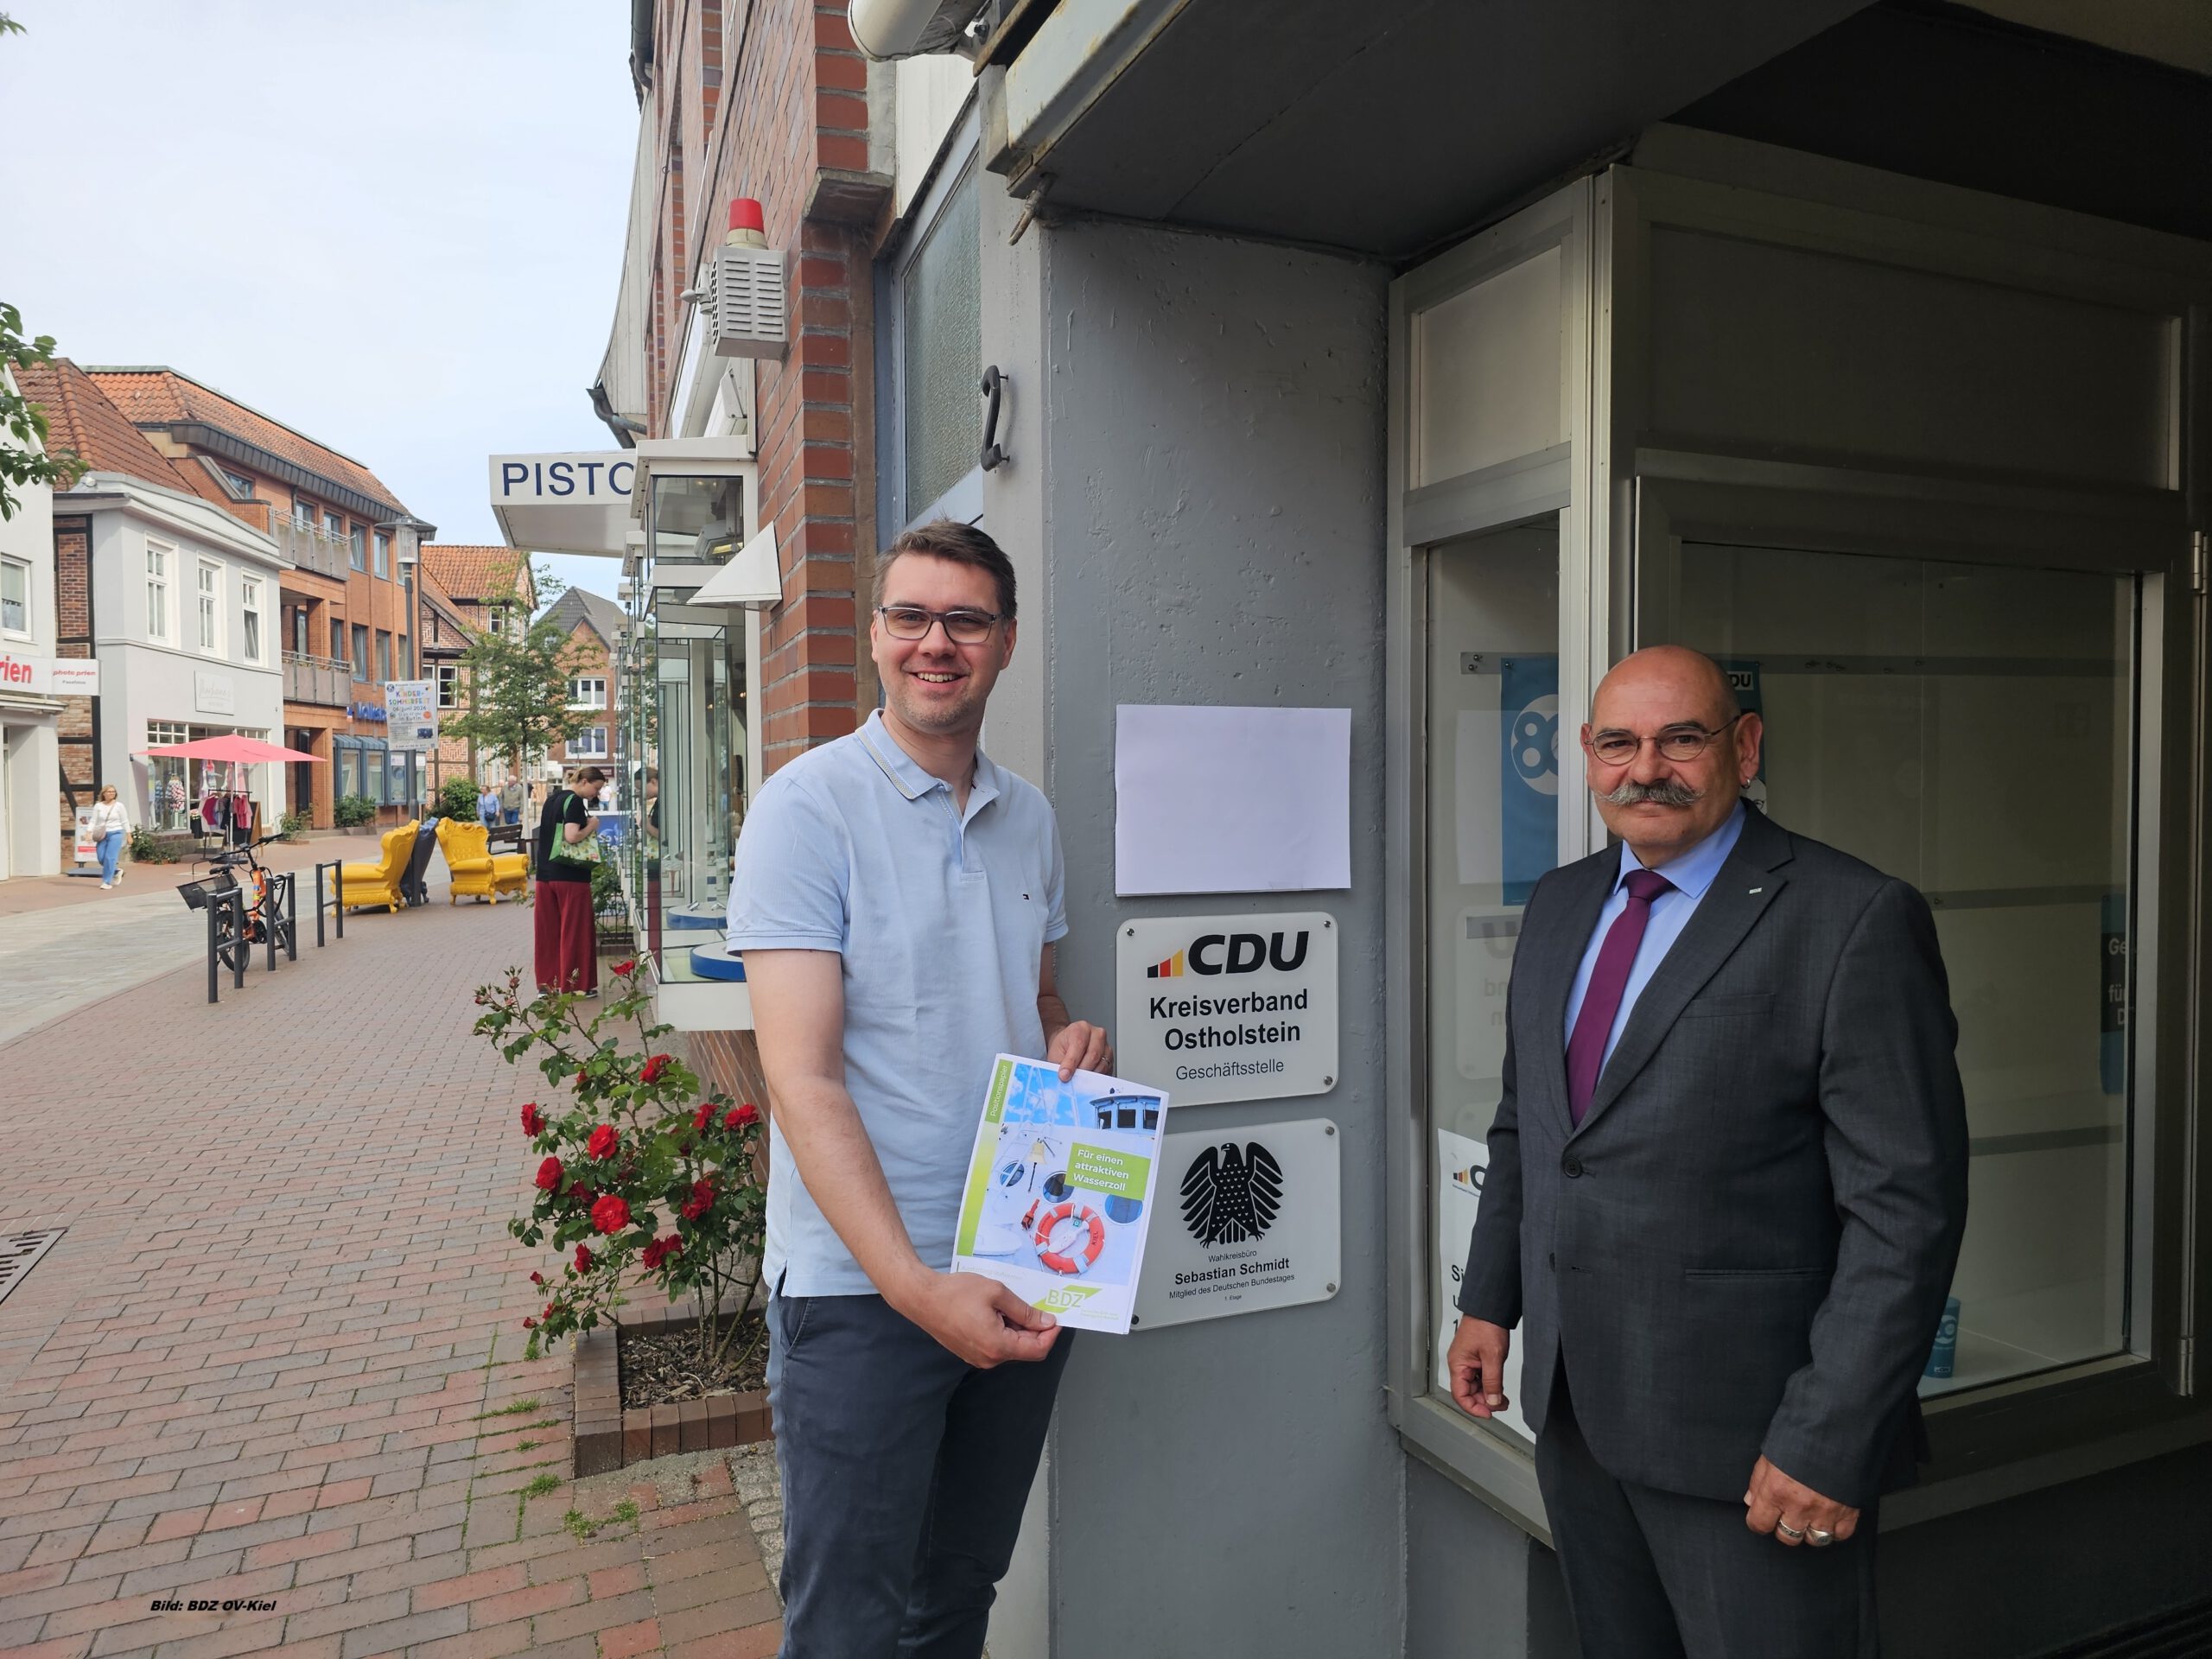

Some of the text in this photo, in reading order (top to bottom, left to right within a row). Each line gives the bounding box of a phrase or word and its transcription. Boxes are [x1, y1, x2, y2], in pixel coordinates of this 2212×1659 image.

[502, 461, 634, 497] PISTO
[1729, 674, 1751, 688] DU
[1513, 710, 1559, 779] 8
[1188, 931, 1310, 976] CDU
[1150, 988, 1308, 1020] Kreisverband
[1165, 1021, 1300, 1051] Ostholstein
[1176, 1058, 1285, 1081] Geschäftsstelle
[989, 1065, 1008, 1117] Positionspapier
[1074, 1162, 1129, 1179] attraktiven
[1077, 1149, 1123, 1166] Für einen
[1072, 1173, 1126, 1191] Wasserzoll
[1208, 1249, 1257, 1262] Wahlkreisbüro
[1174, 1257, 1290, 1285] Sebastian Schmidt
[1047, 1289, 1084, 1307] BDZ
[1169, 1274, 1295, 1300] Mitglied des Deutschen Bundestages
